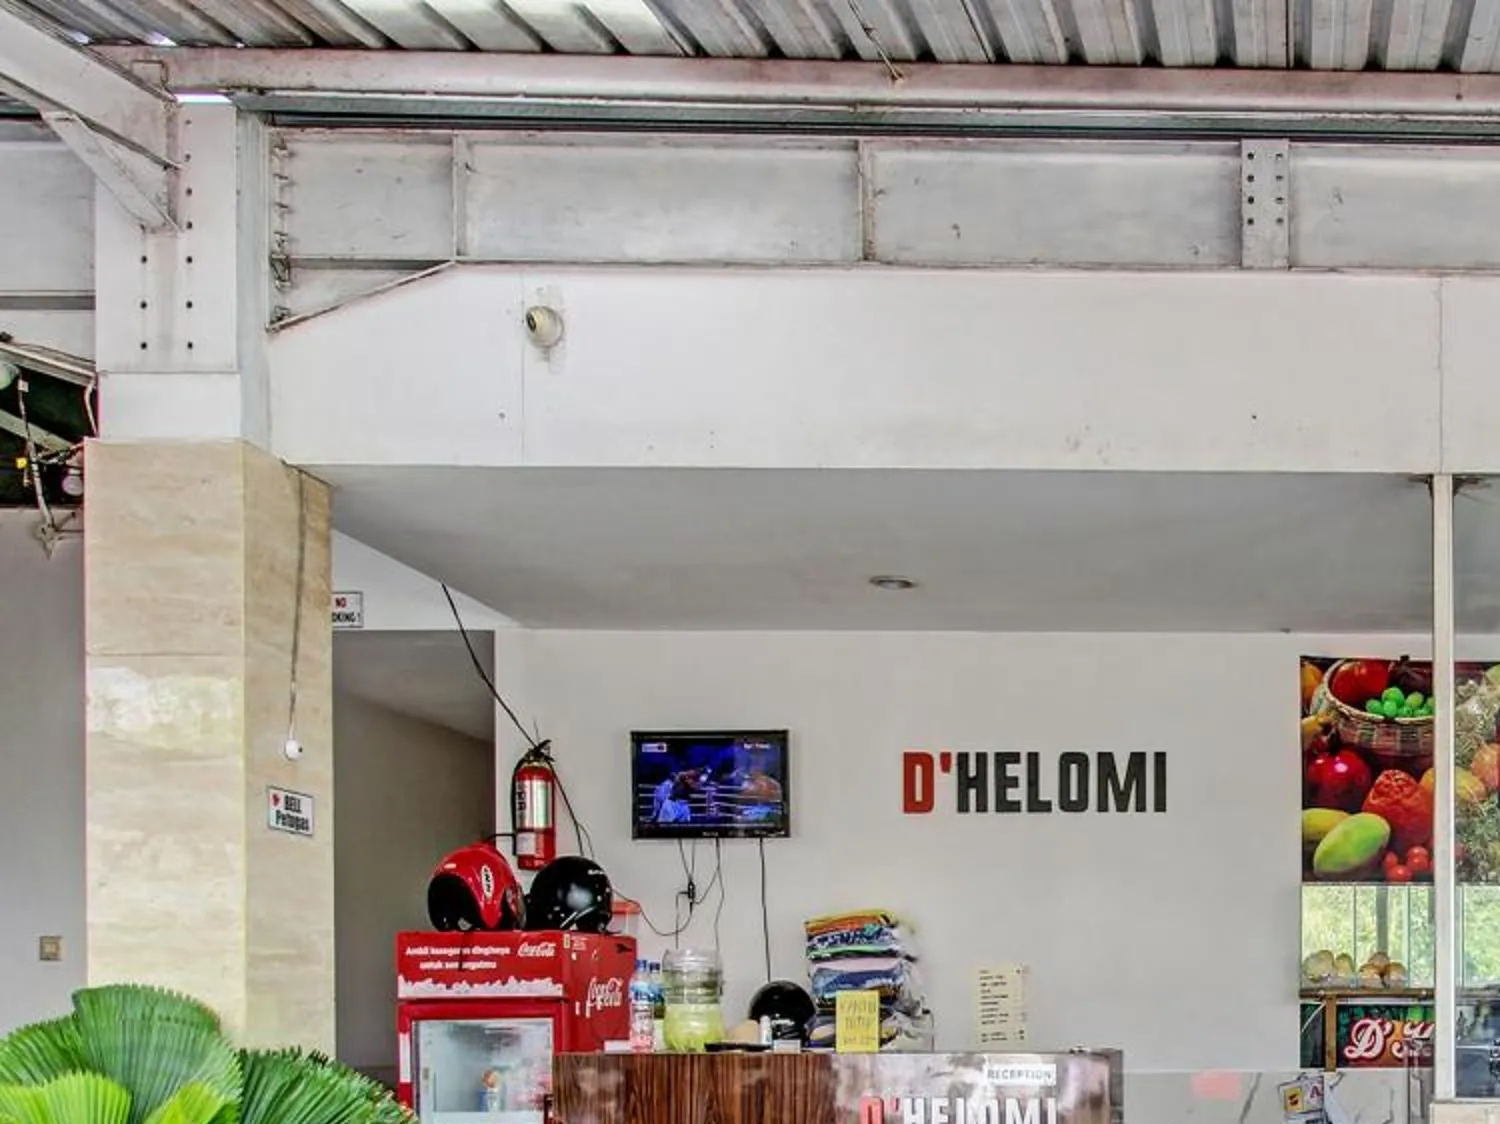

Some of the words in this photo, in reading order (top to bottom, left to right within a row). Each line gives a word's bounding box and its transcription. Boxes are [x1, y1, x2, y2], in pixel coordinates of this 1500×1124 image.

[335, 597, 347, 609] NO
[331, 611, 356, 623] OKING
[903, 751, 1167, 813] D'HELOMI
[284, 794, 302, 814] BELL
[275, 810, 309, 831] Petugas
[986, 1068, 1053, 1081] RECEPTION
